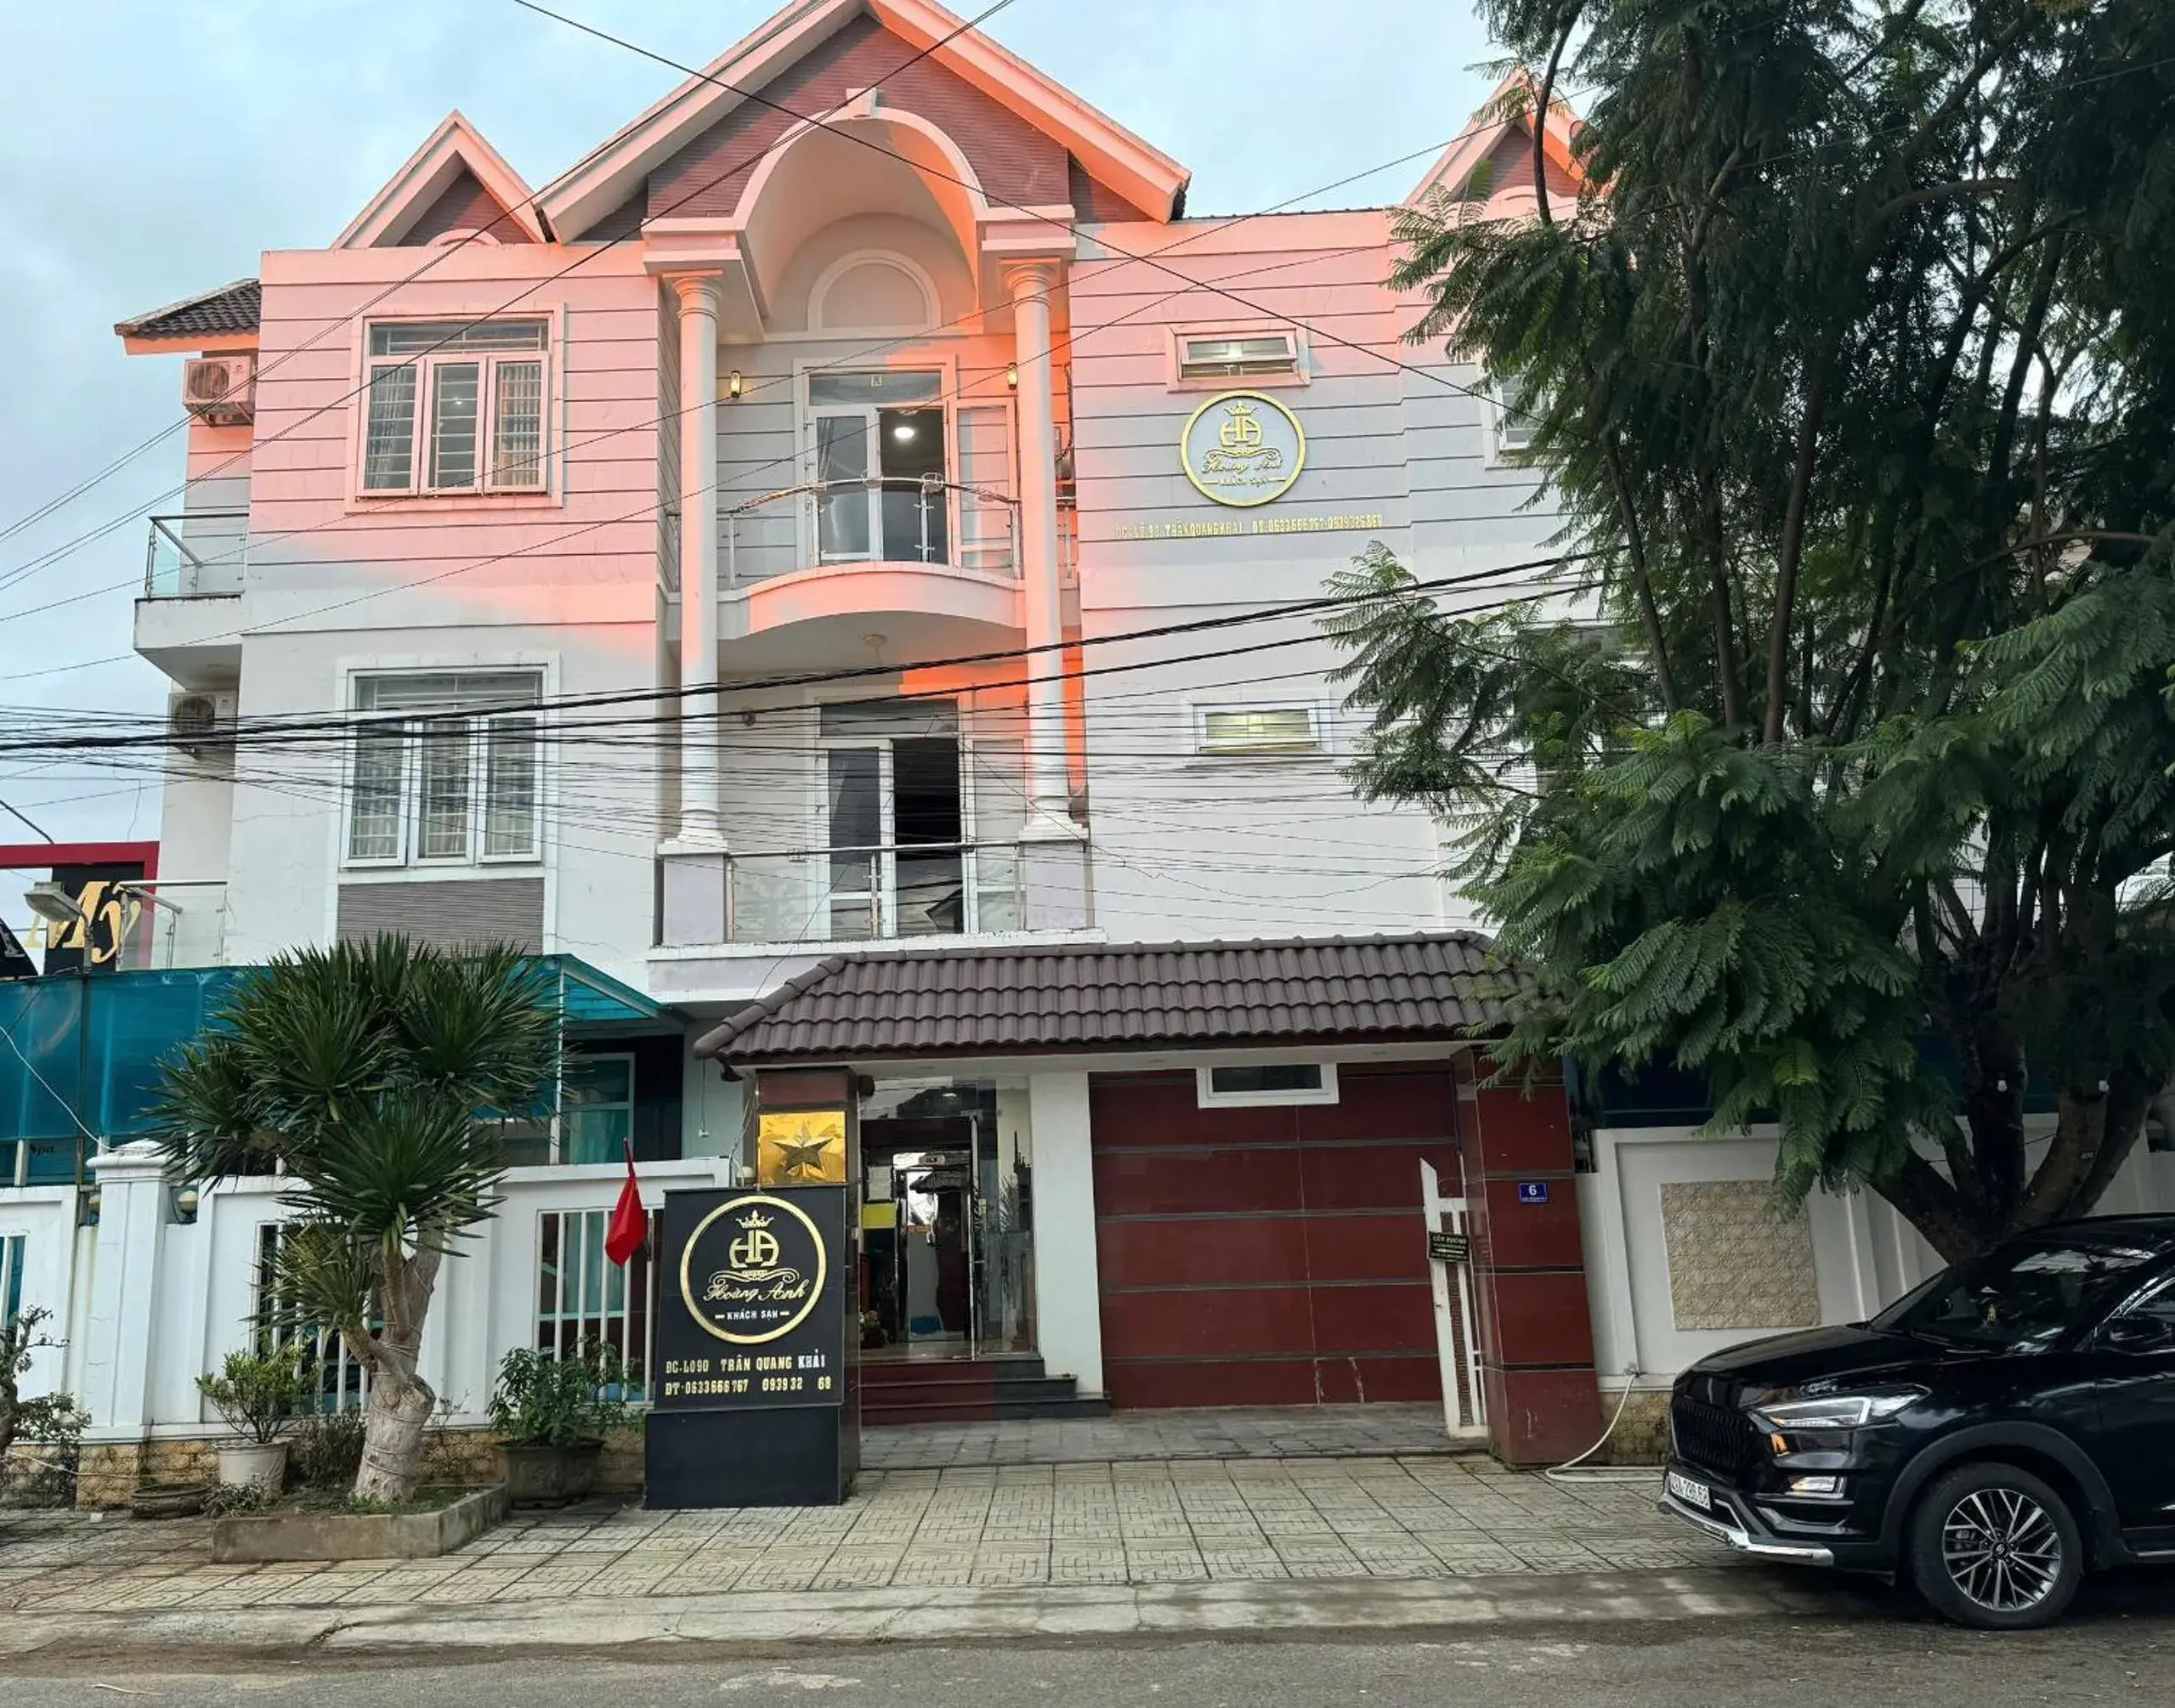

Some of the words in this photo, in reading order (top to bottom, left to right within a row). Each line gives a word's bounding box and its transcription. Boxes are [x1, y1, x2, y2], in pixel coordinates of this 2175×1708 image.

[1529, 1185, 1537, 1196] 6
[758, 1279, 809, 1301] Anh
[728, 1309, 757, 1321] KHÁCH
[761, 1309, 778, 1321] SẠN
[756, 1356, 792, 1371] QUANG
